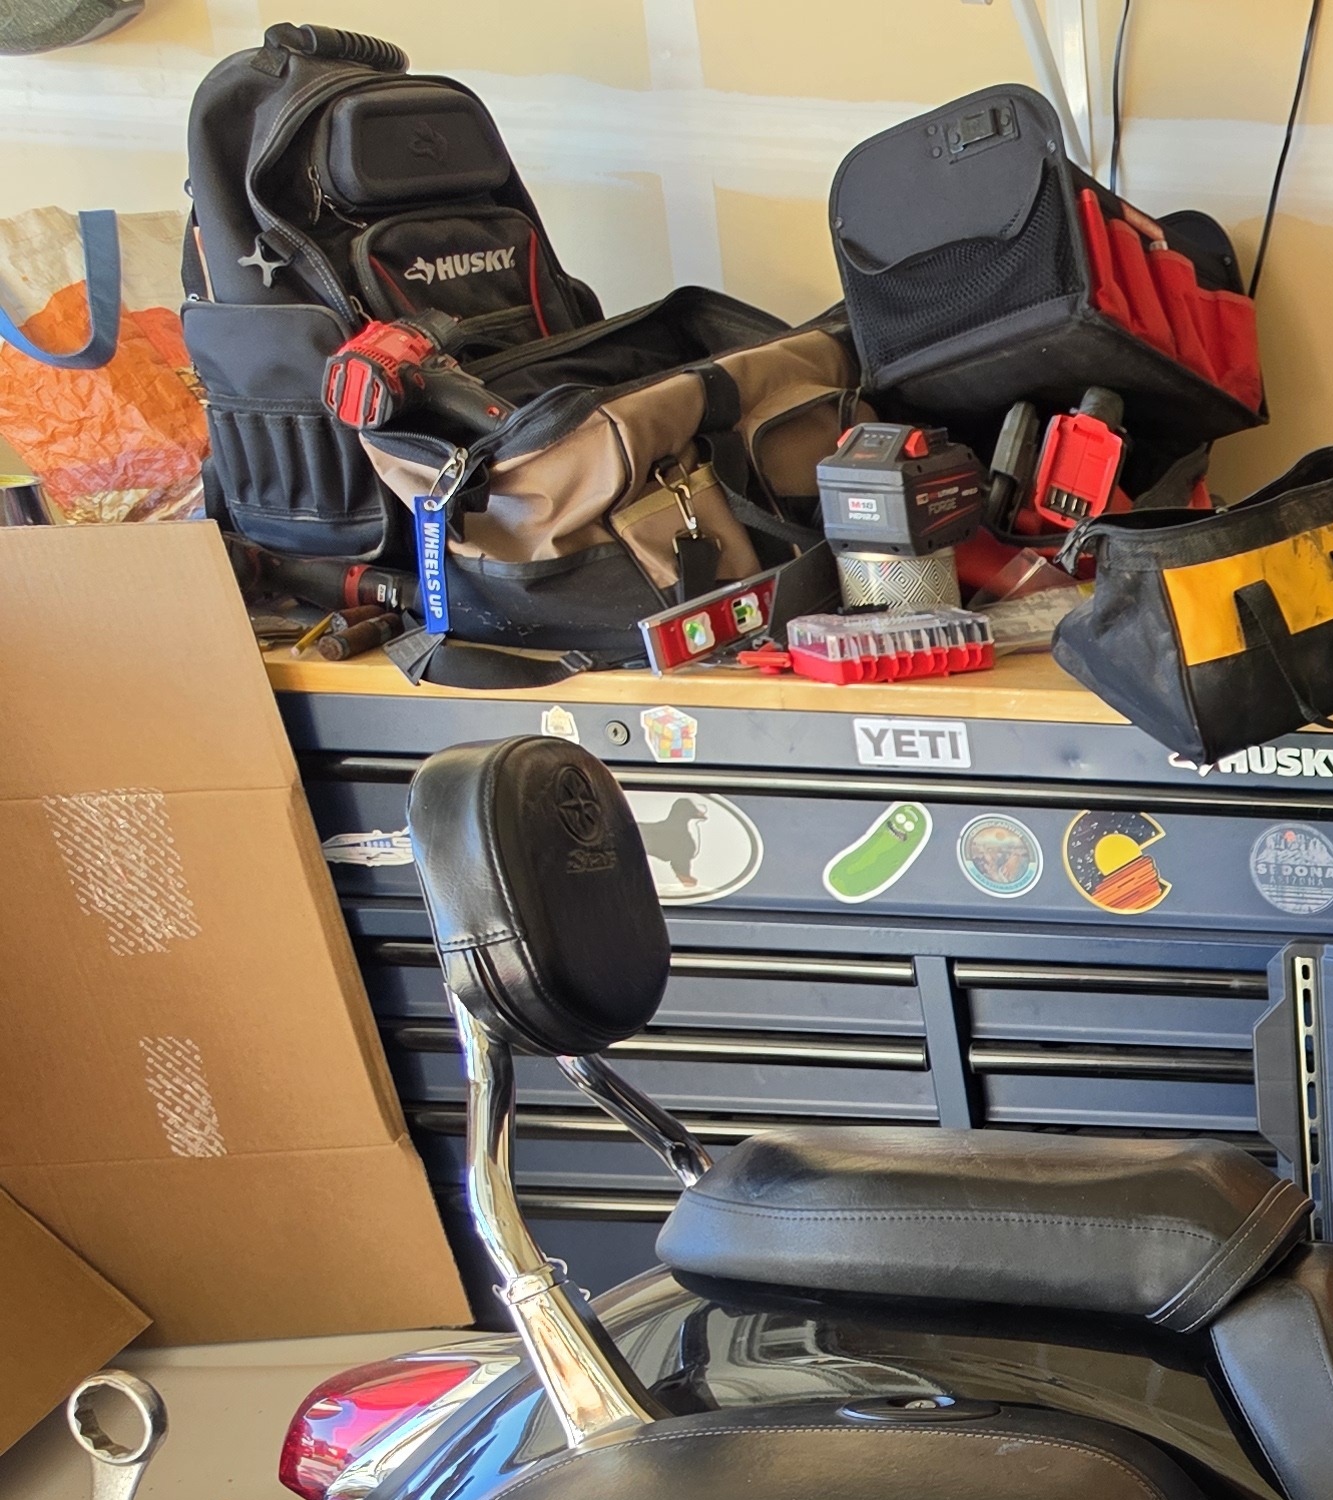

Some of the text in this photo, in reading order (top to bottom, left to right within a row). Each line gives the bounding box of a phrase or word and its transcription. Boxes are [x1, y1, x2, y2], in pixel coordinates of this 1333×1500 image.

[436, 246, 515, 281] HUSKY
[423, 522, 443, 619] WHEELS UP
[860, 726, 961, 761] YETI
